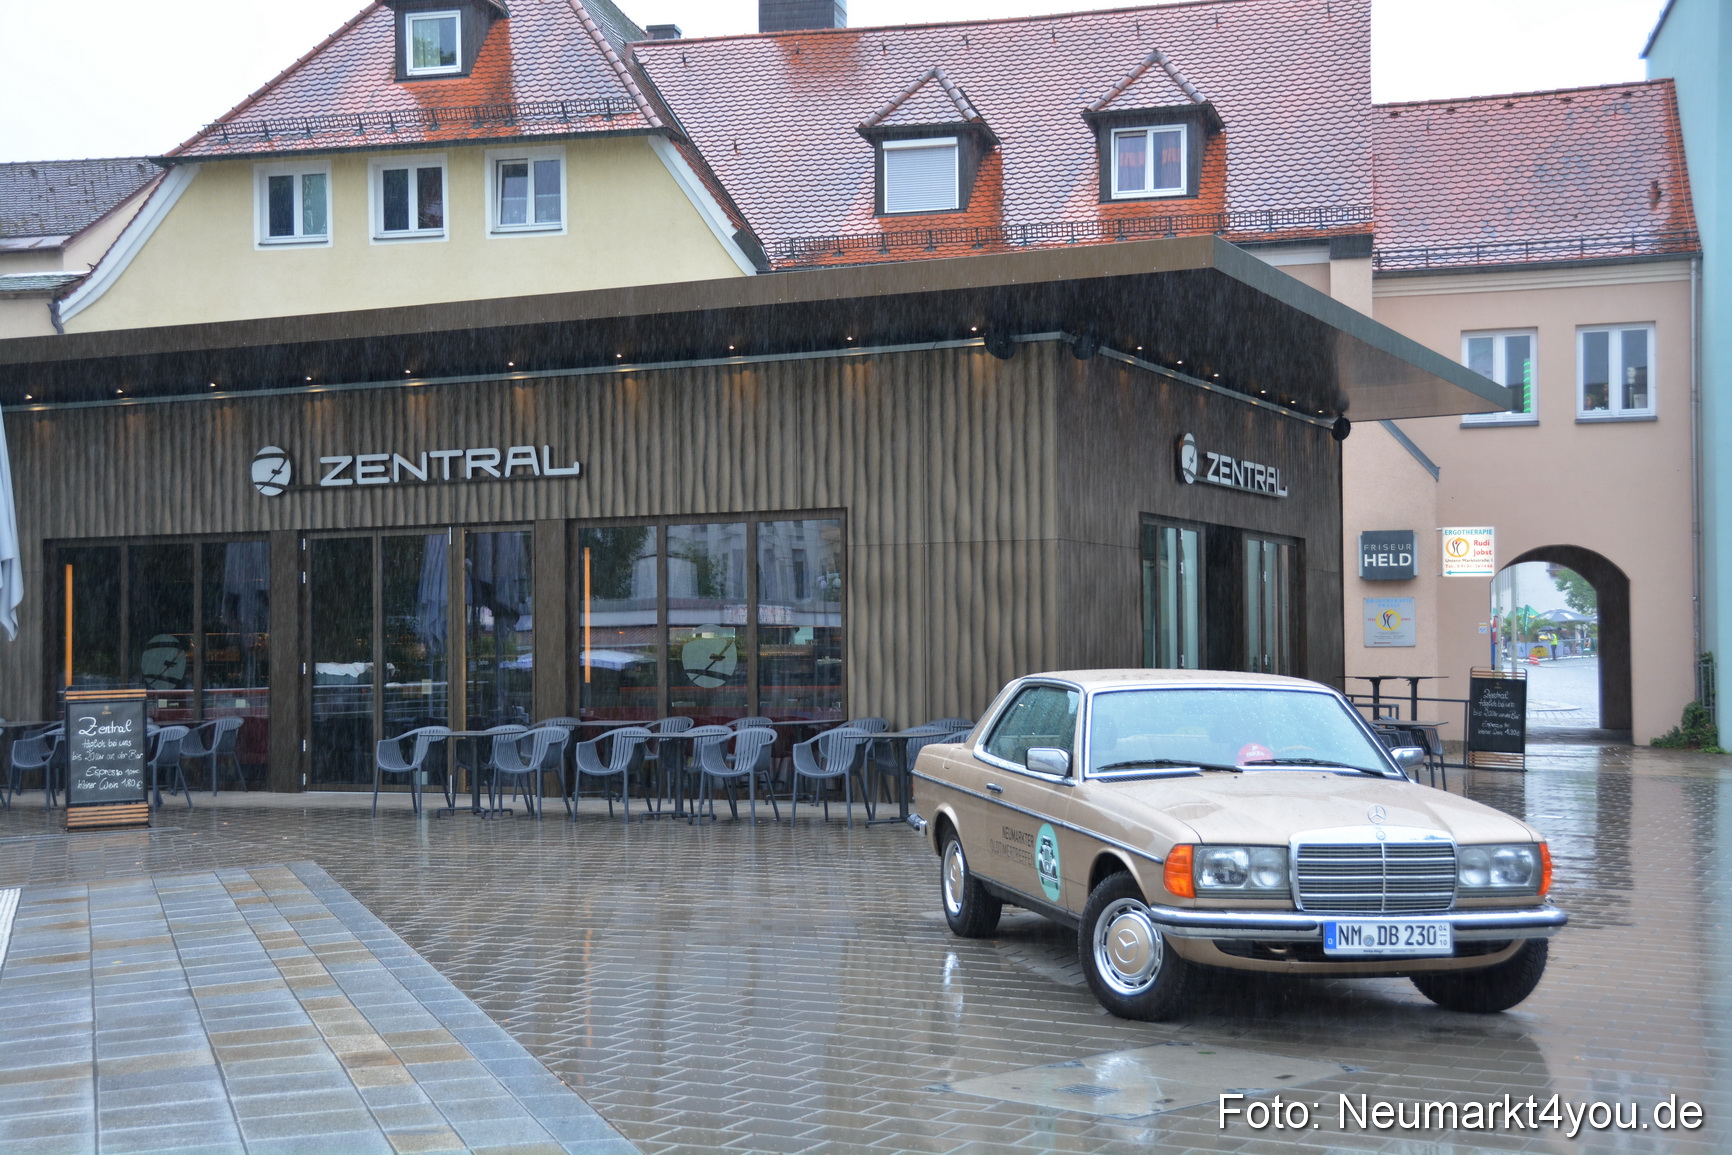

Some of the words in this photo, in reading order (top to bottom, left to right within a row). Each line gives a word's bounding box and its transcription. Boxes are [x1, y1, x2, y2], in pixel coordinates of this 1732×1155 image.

[319, 445, 580, 487] ZENTRAL
[1206, 451, 1288, 497] ZENTRAL
[1363, 543, 1412, 551] FRISEUR
[1473, 539, 1490, 547] Rudi
[1364, 552, 1412, 567] HELD
[1473, 549, 1493, 557] Jobst
[78, 716, 132, 737] Zentral
[82, 739, 106, 752] täglich
[108, 739, 117, 748] bei
[71, 751, 82, 761] bis
[128, 749, 144, 760] Bar
[85, 766, 123, 778] Espresso
[99, 777, 119, 790] Wein
[1338, 925, 1362, 946] NM
[1376, 925, 1399, 946] DB
[1404, 925, 1437, 946] 230
